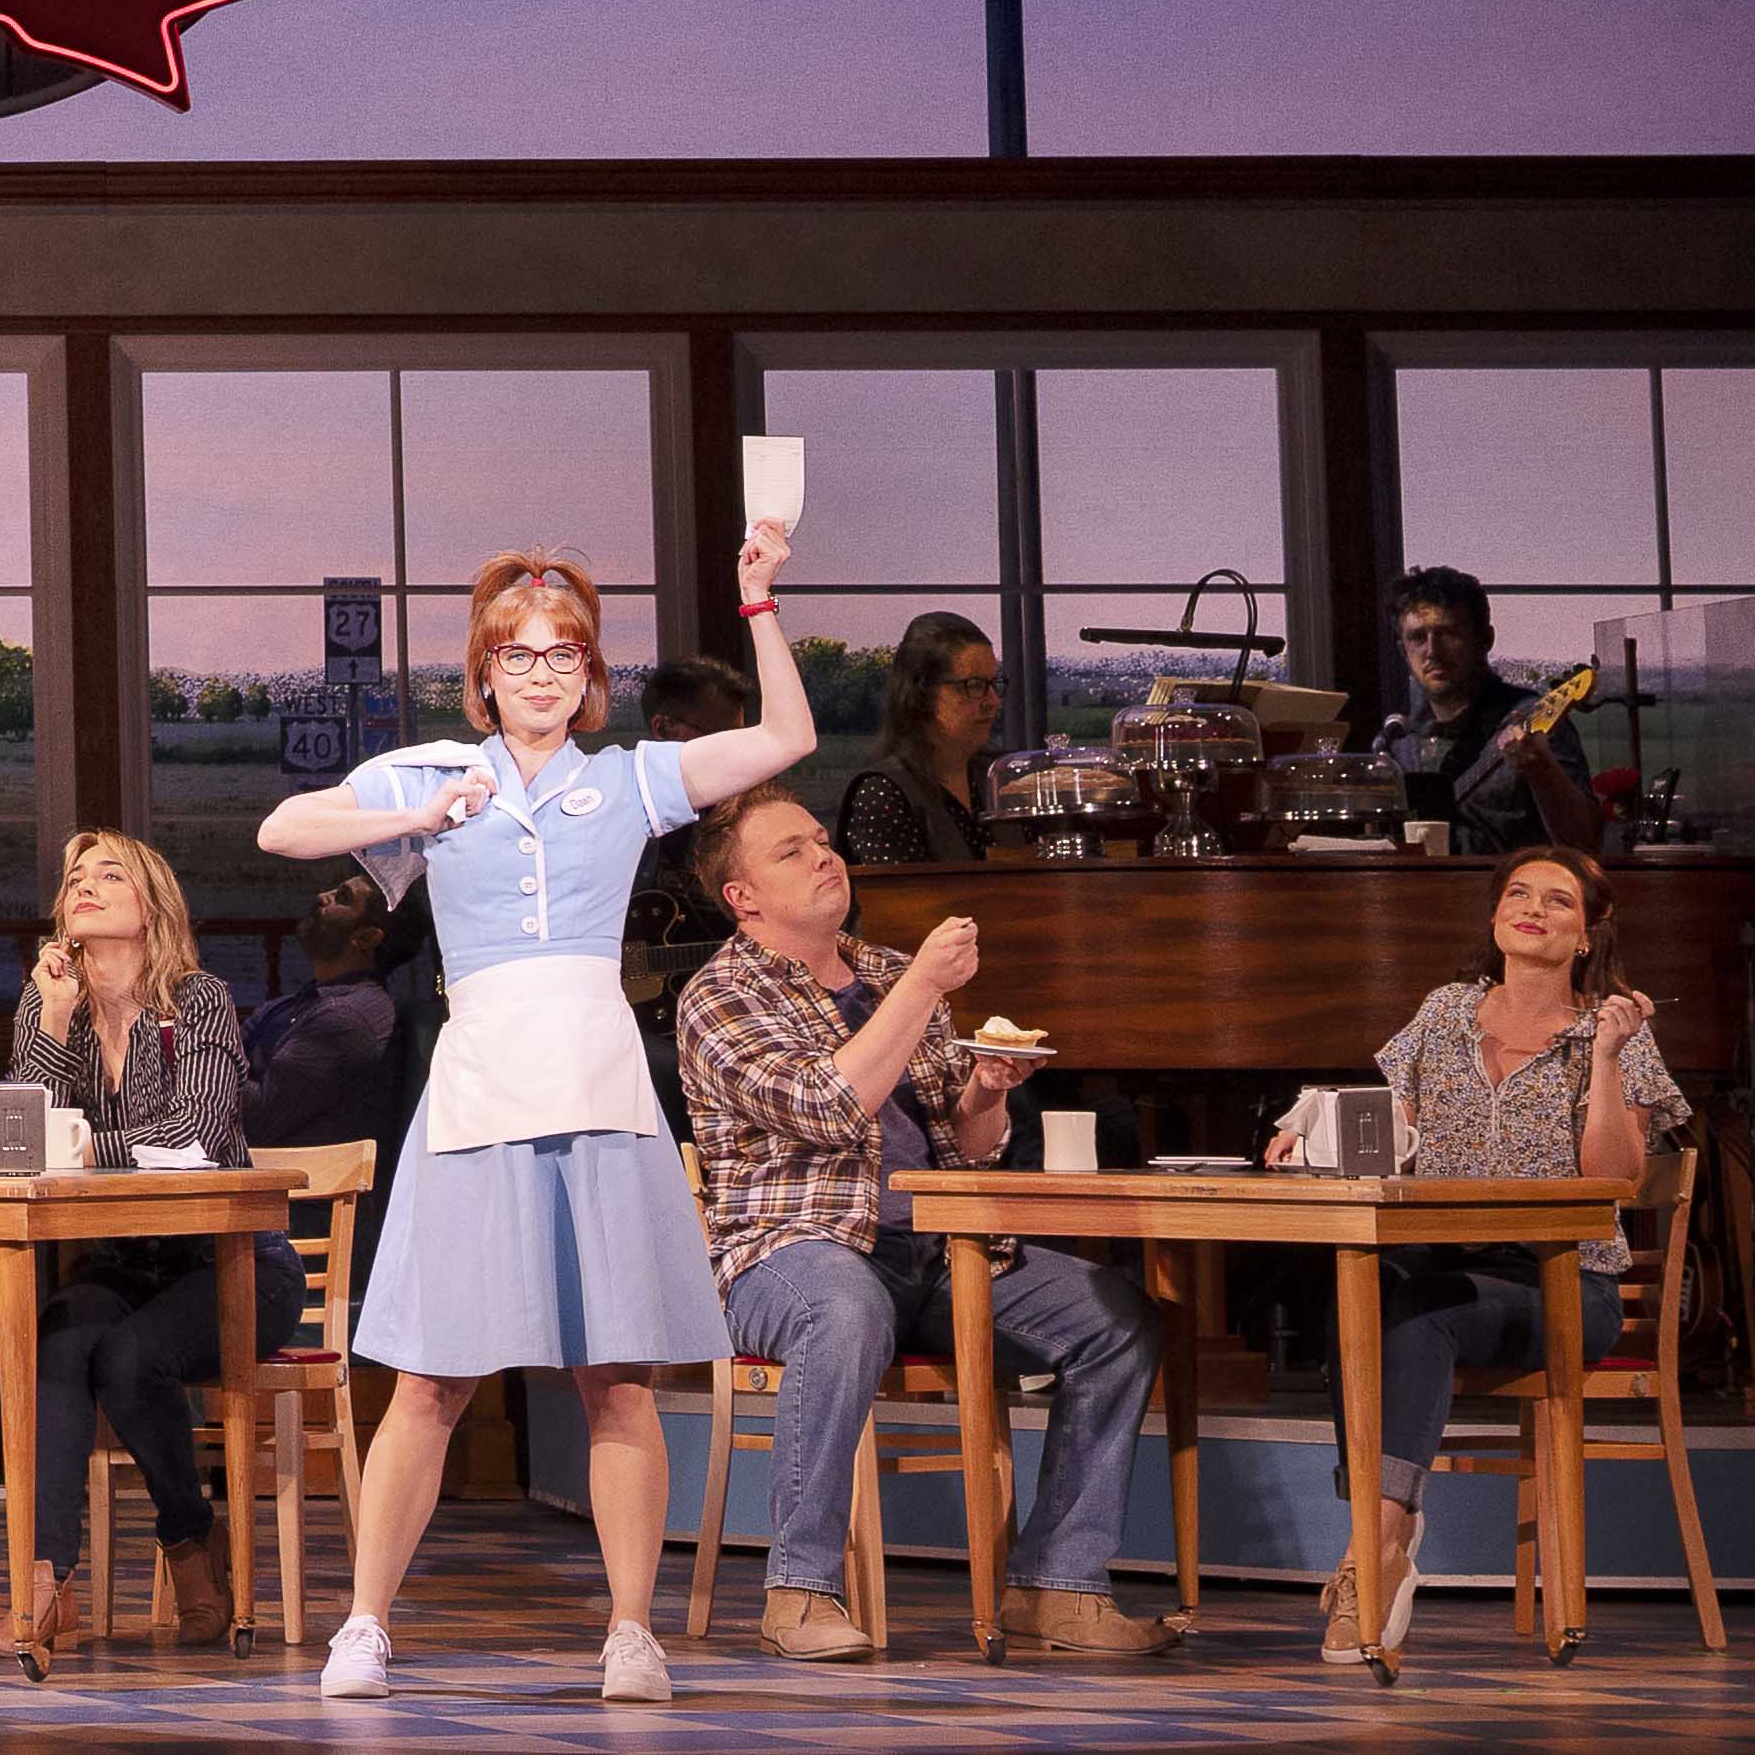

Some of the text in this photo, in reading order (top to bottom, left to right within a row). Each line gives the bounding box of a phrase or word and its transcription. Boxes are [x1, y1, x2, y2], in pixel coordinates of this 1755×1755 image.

[335, 611, 370, 636] 27
[285, 697, 341, 714] WEST
[293, 734, 331, 759] 40
